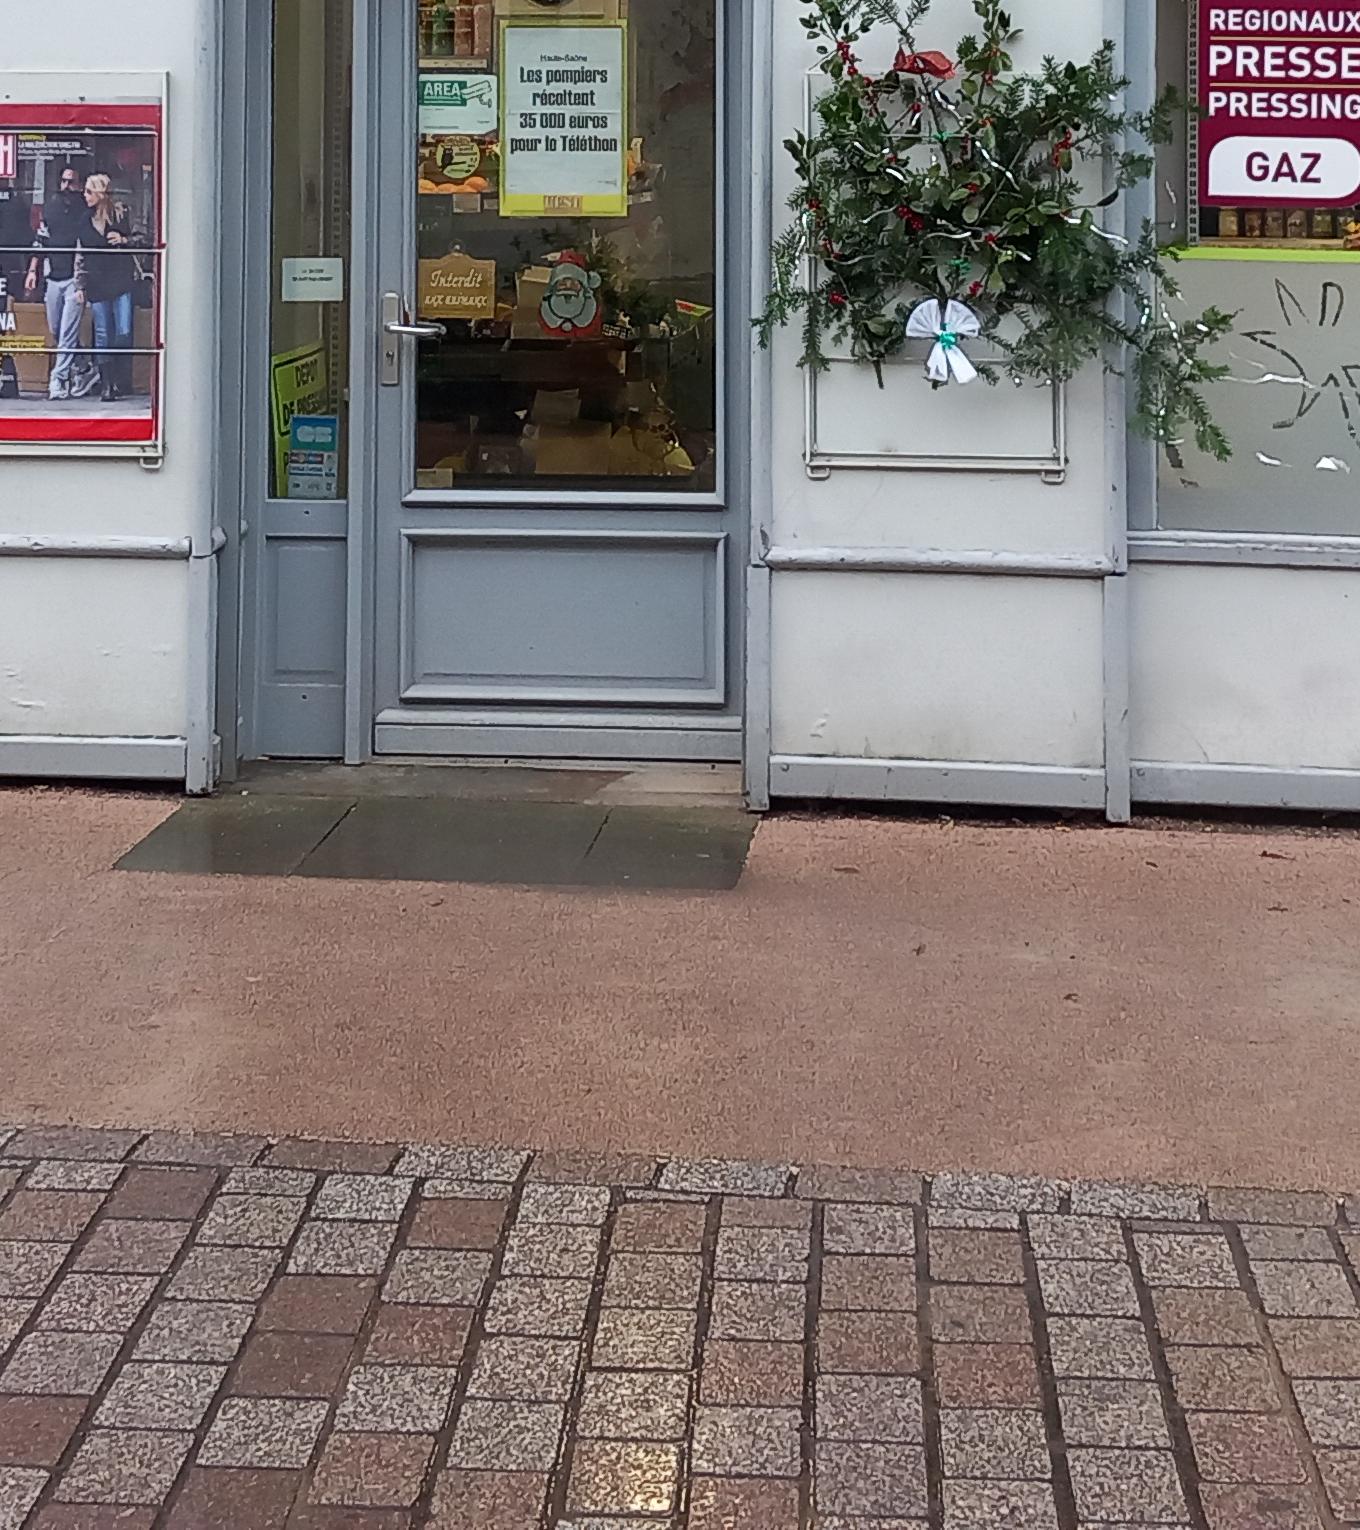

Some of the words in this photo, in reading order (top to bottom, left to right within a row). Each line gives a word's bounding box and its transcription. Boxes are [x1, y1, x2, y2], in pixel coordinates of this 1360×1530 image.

[520, 66, 542, 84] Les
[546, 66, 608, 86] pompiers
[424, 82, 461, 96] AREA
[532, 89, 596, 106] récoltent
[520, 112, 536, 129] 35
[540, 113, 565, 129] 000
[569, 115, 608, 129] euros
[510, 137, 542, 154] pour
[560, 134, 617, 152] Téléthon
[1245, 151, 1322, 184] GAZ
[430, 268, 483, 288] Interdit
[445, 292, 488, 308] animaux
